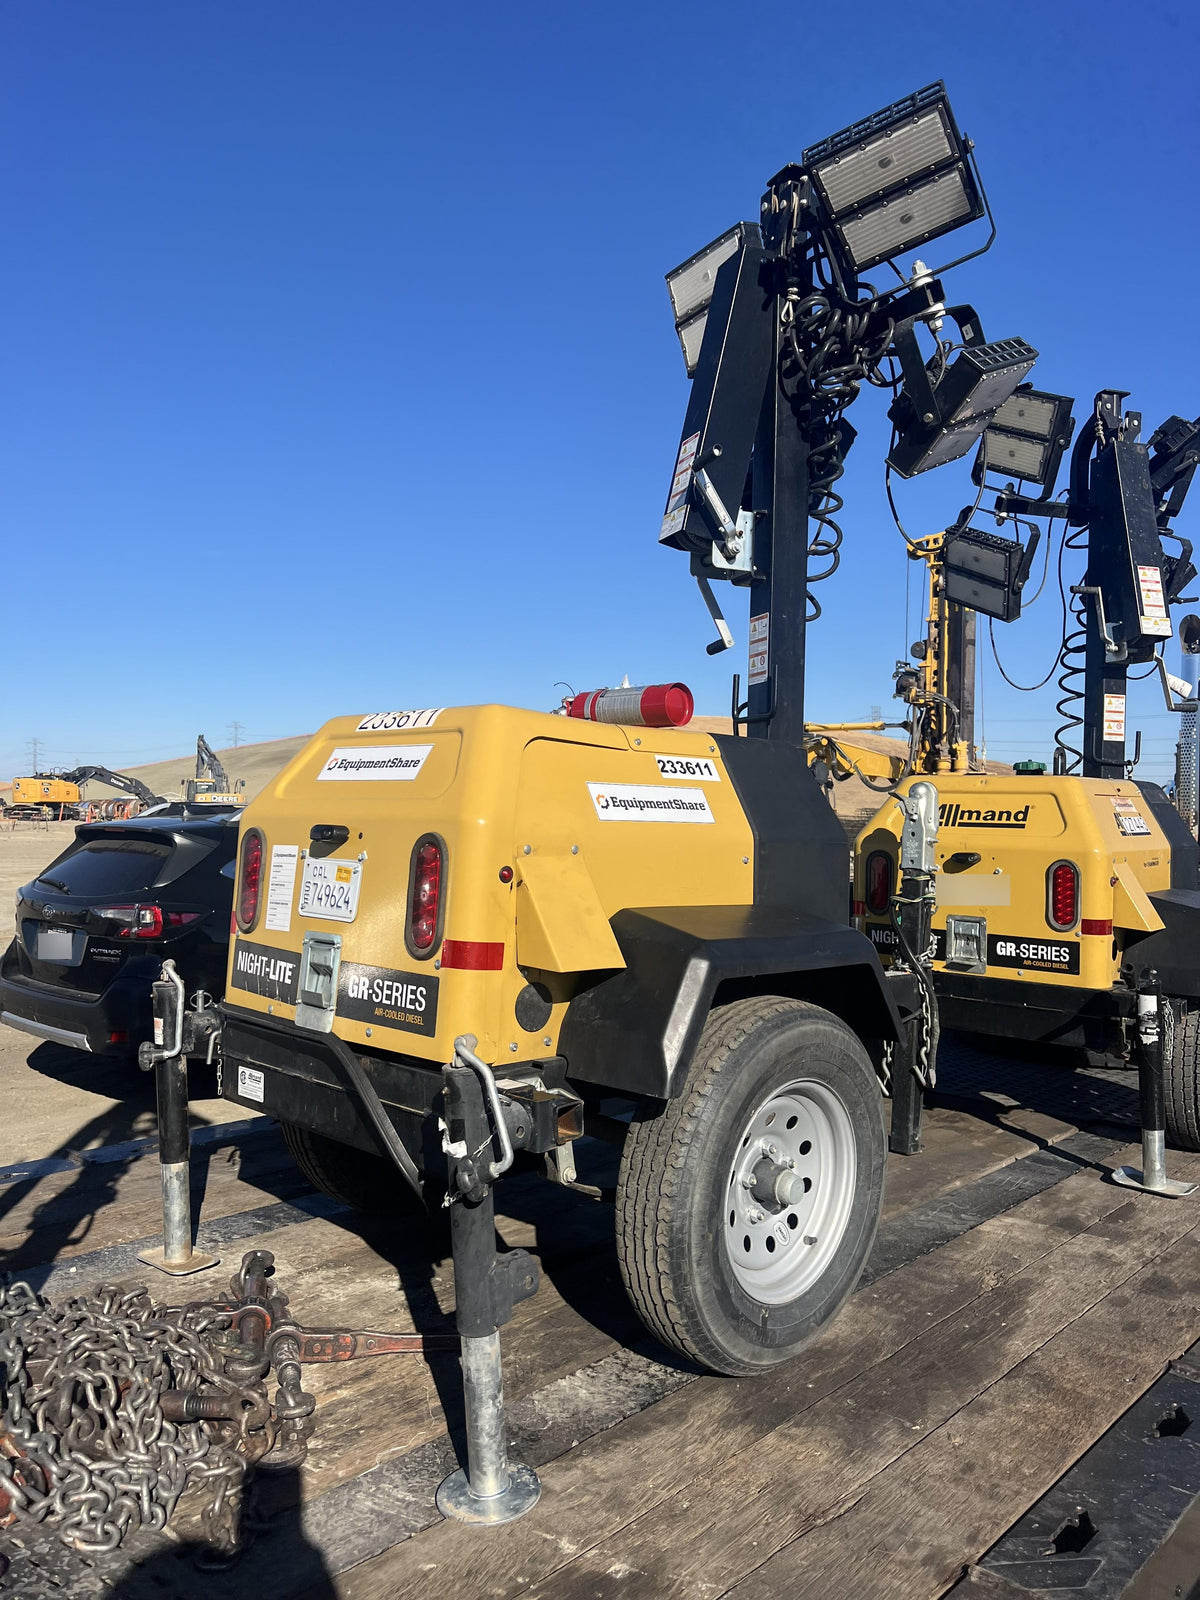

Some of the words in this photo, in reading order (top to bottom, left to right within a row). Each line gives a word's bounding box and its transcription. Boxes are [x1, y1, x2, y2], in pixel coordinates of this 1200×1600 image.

[337, 756, 419, 771] EquipmentShare
[657, 759, 713, 777] 233611
[211, 795, 238, 803] DEERE
[610, 796, 705, 811] EquipmentShare
[312, 866, 329, 880] CAL
[312, 882, 351, 911] 749624
[995, 941, 1070, 963] GR-SERIES
[236, 949, 294, 985] NIGHT-LITE
[1023, 959, 1052, 969] AIR-COOLED
[1052, 961, 1070, 970] DIESEL
[347, 974, 427, 1012] GR-SERIES
[374, 1006, 405, 1022] AIR-COOLED
[405, 1012, 424, 1026] DIESEL
